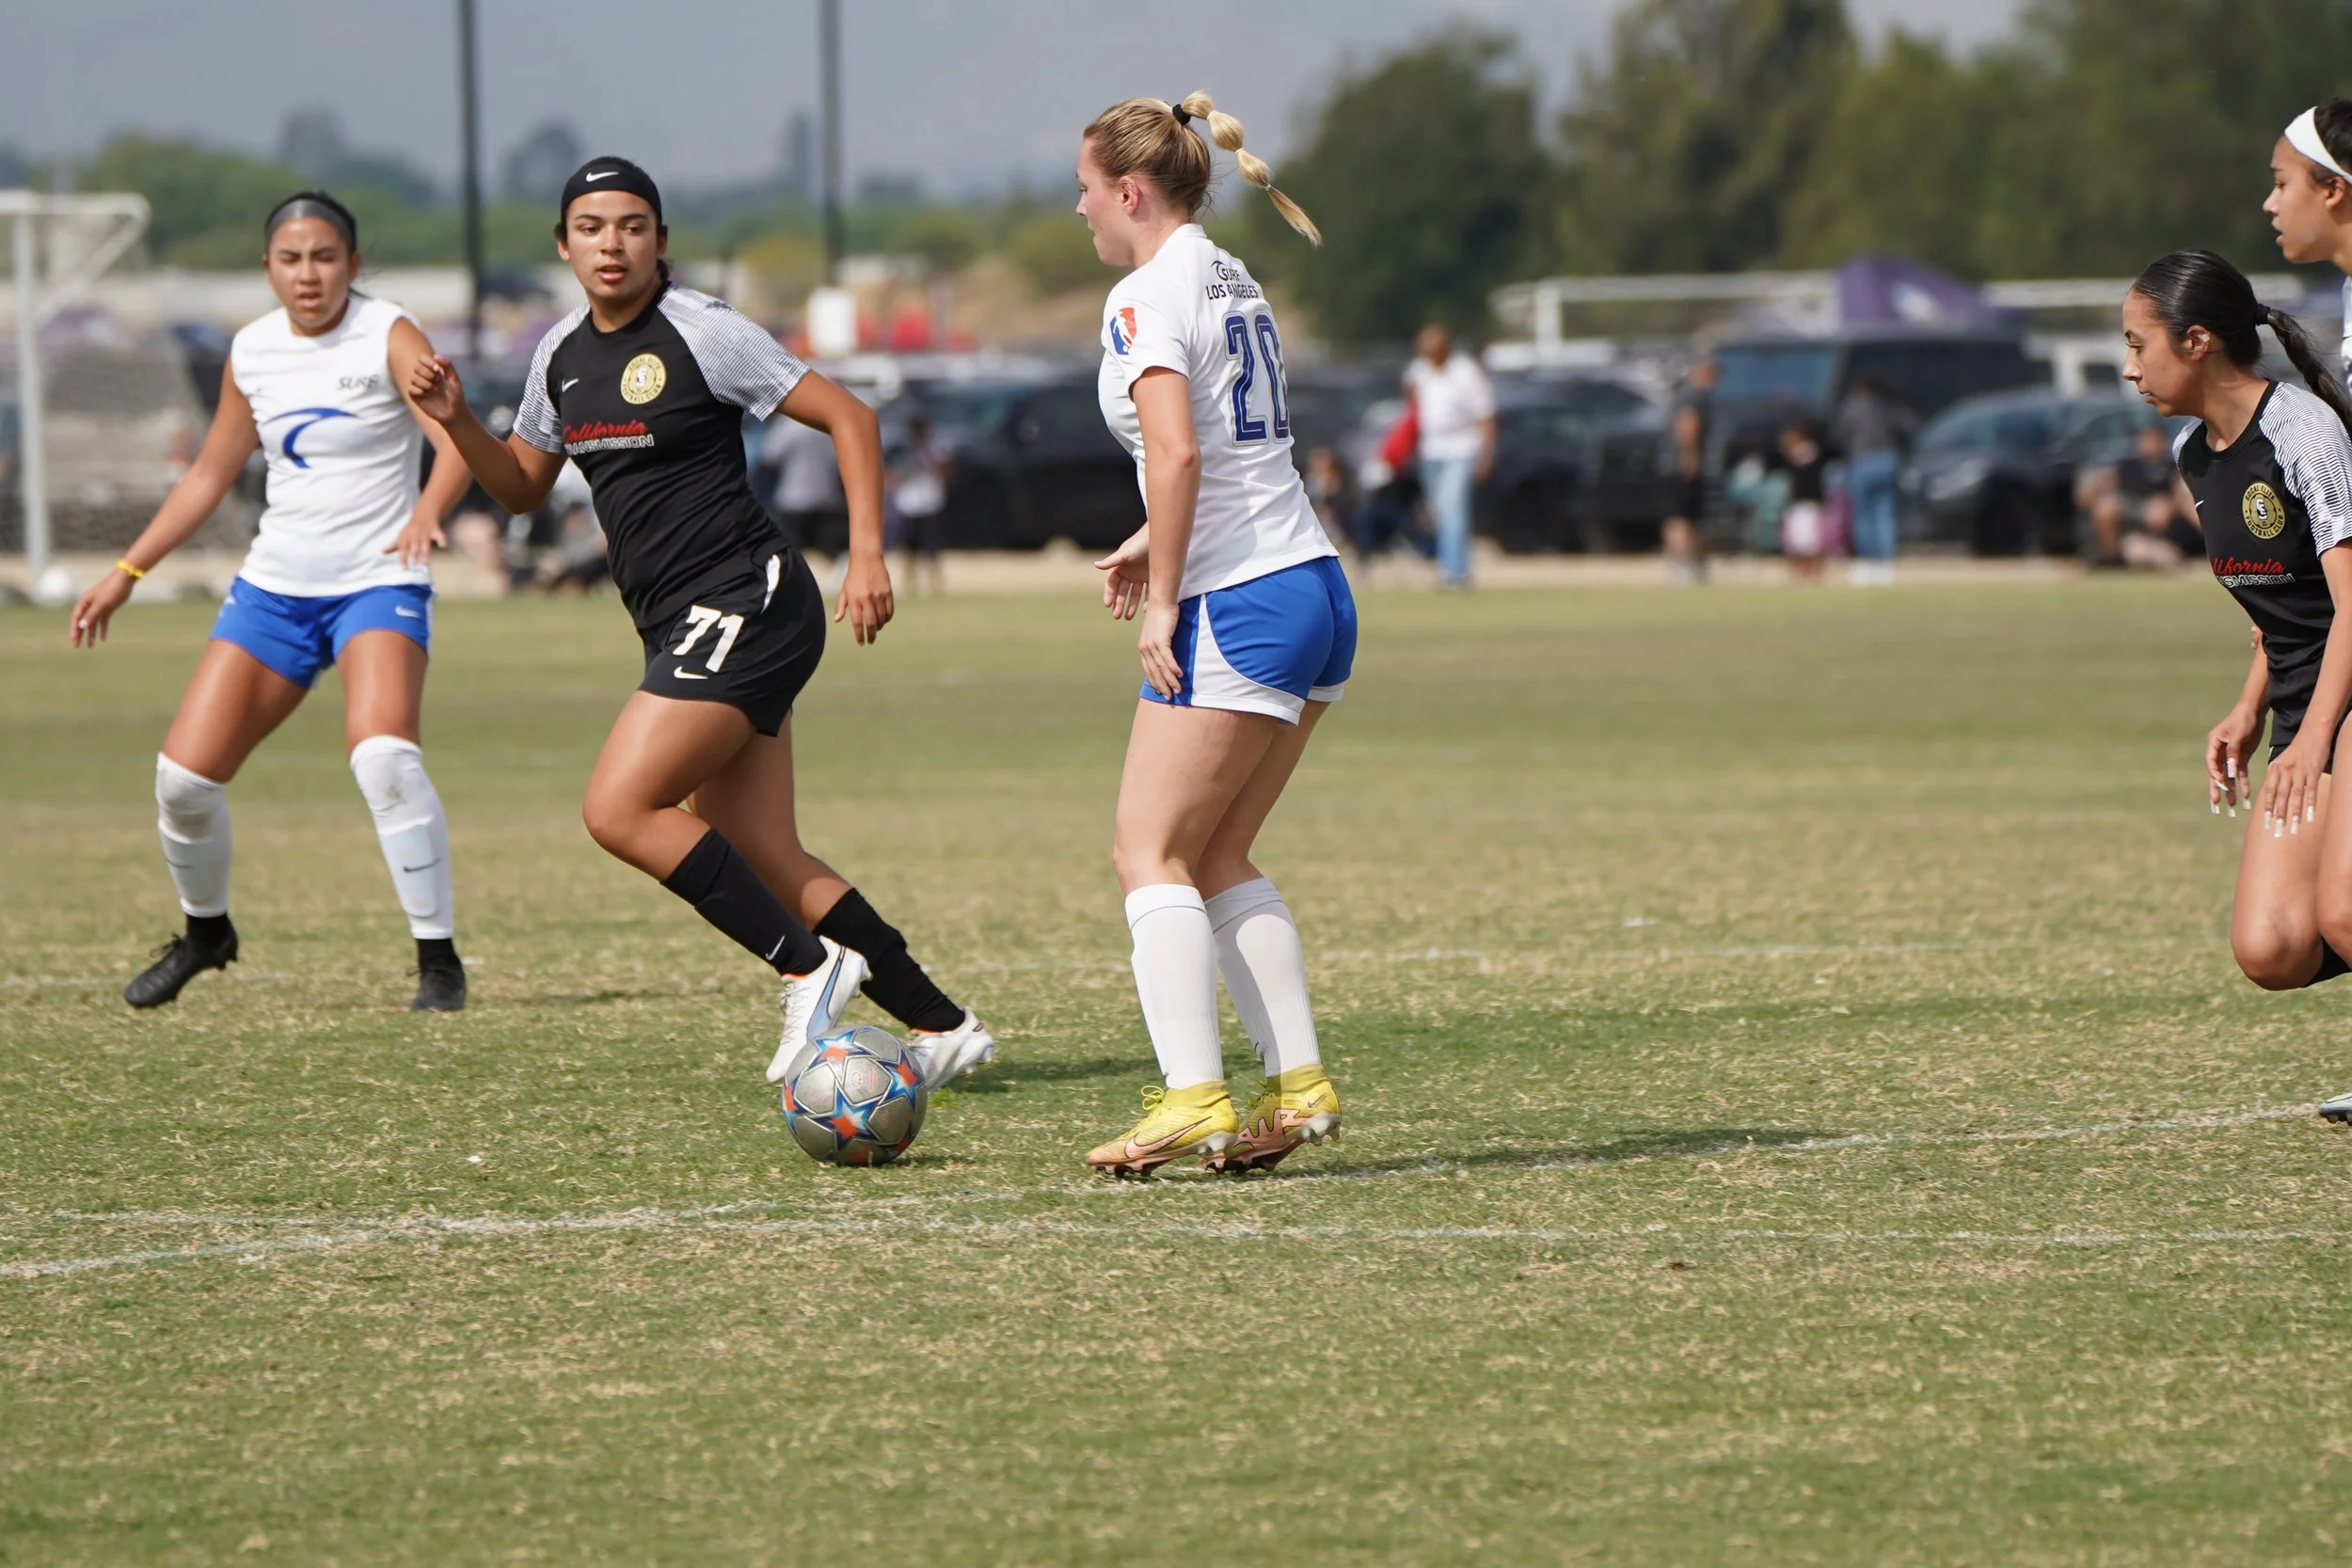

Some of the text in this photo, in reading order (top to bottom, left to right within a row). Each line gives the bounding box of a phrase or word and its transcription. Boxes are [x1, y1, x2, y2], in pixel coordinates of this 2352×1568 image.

[1221, 267, 1240, 281] SURF
[1205, 283, 1259, 300] LOS ANGELES
[1223, 309, 1291, 447] 20
[562, 419, 647, 444] California
[564, 434, 655, 455] RANSMISSION
[2273, 515, 2284, 533] CLUB
[2213, 556, 2285, 575] lifornia
[673, 605, 744, 673] 71
